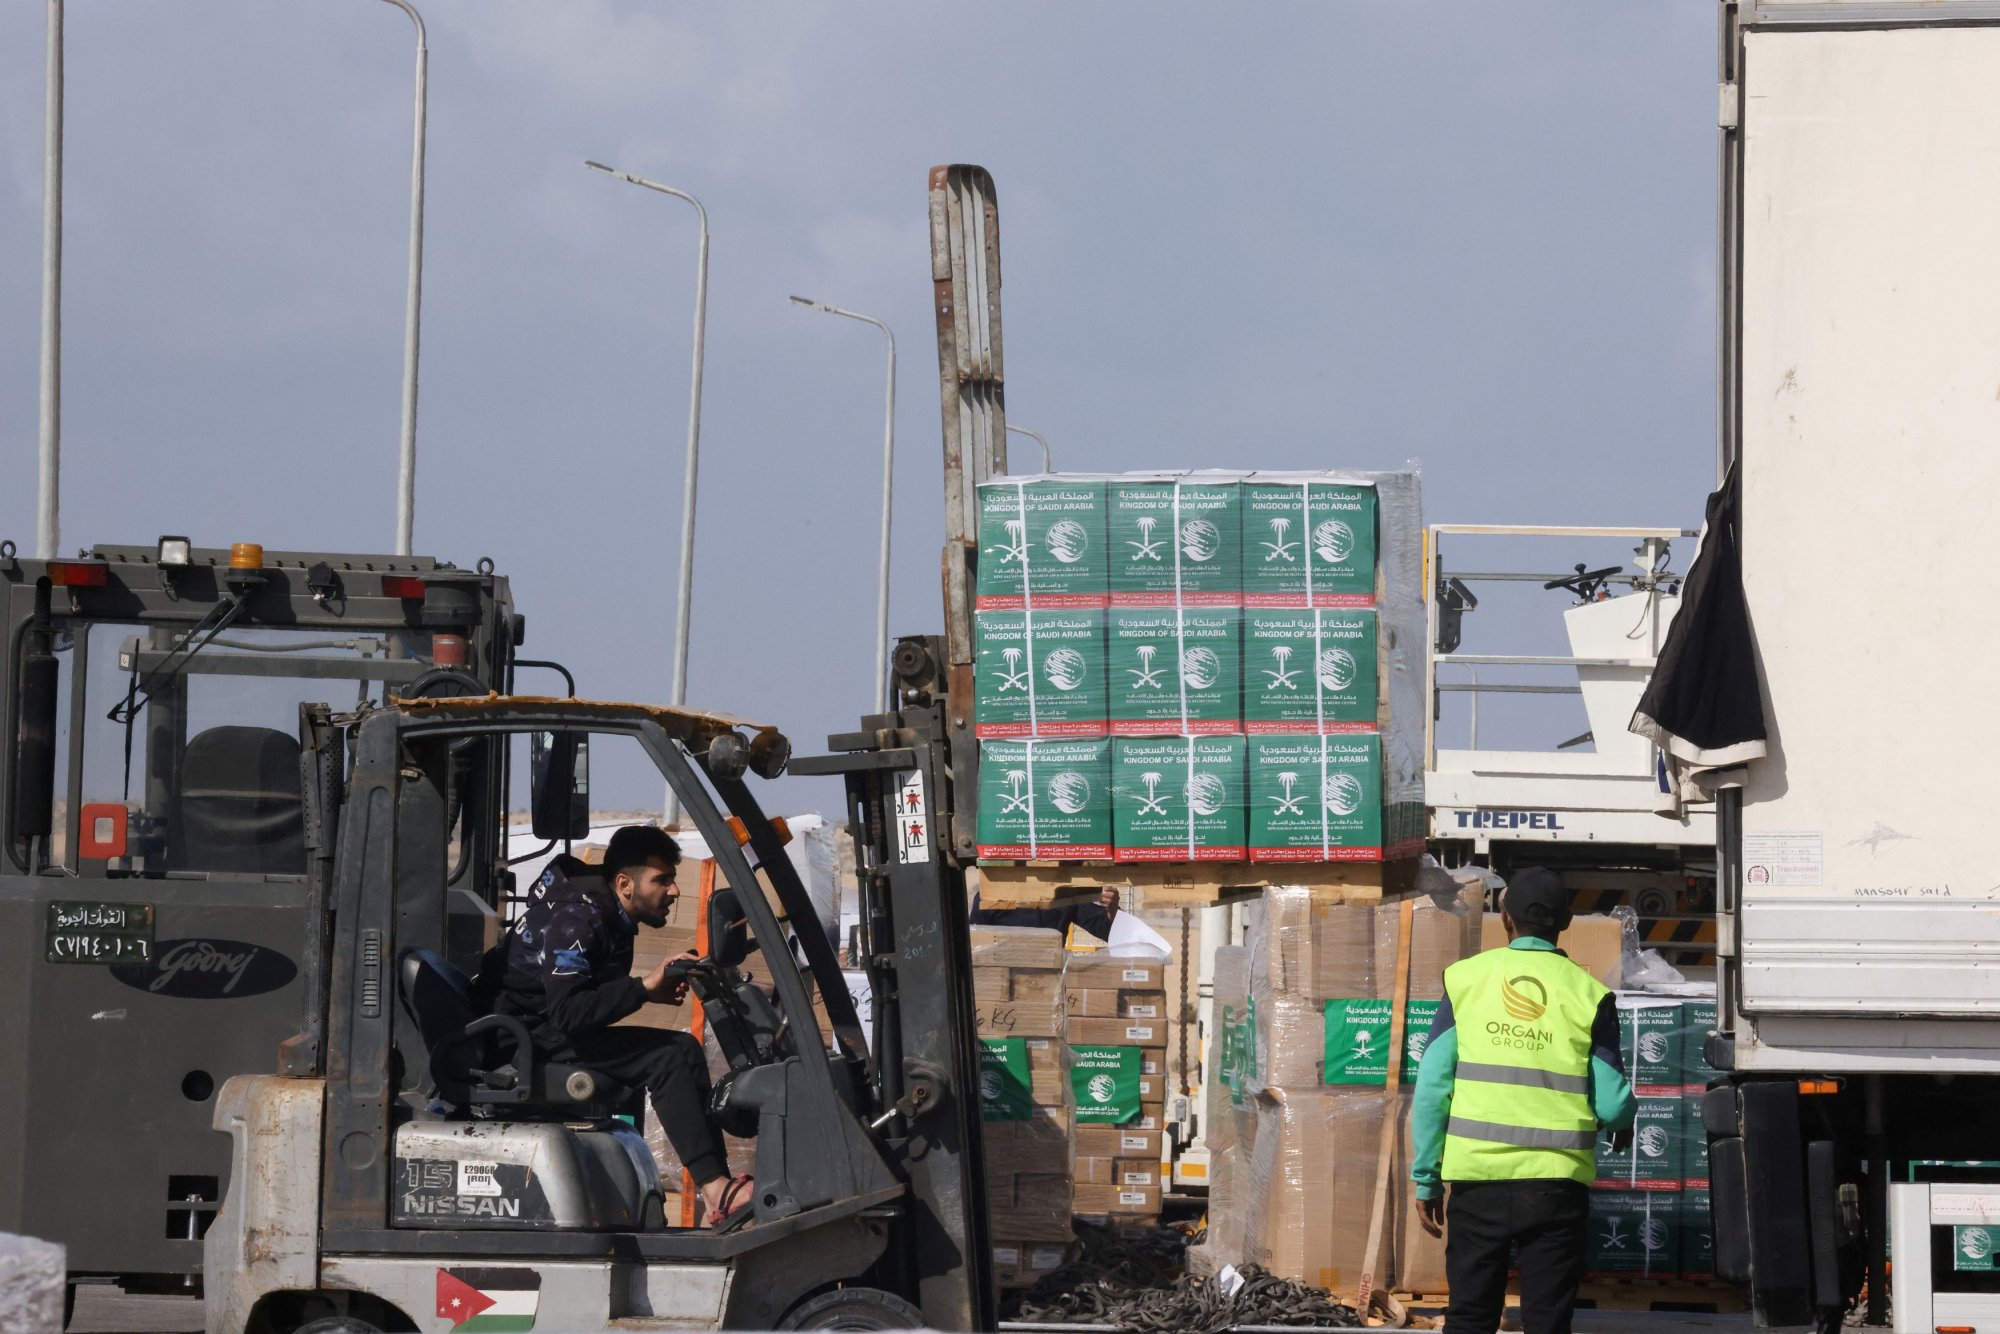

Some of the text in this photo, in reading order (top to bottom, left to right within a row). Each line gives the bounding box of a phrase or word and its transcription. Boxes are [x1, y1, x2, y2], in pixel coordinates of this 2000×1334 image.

[1059, 492, 1093, 500] المملكة
[1119, 491, 1160, 502] السعودية
[1193, 492, 1227, 500] المملكة
[1252, 491, 1294, 501] السعودية
[1057, 620, 1092, 628] المملكة
[1118, 619, 1159, 629] السعودية
[1192, 619, 1226, 627] المملكة
[1254, 619, 1296, 629] السعودية
[1329, 620, 1363, 628] المملكة
[984, 632, 1021, 640] KINGDOM
[1062, 630, 1092, 638] ARABIA
[1123, 746, 1165, 756] السعودية
[1198, 745, 1232, 753] المملكة
[1259, 745, 1301, 756] السعودية
[1334, 745, 1368, 753] المملكة
[1454, 810, 1565, 830] TREPEL
[1920, 884, 1951, 897] said
[149, 941, 258, 993] Godrej
[992, 1008, 1016, 1031] KG
[1486, 1021, 1552, 1044] ORGANI
[1491, 1036, 1545, 1052] GROUP
[406, 1162, 452, 1188] 15
[404, 1195, 520, 1217] NISSAN
